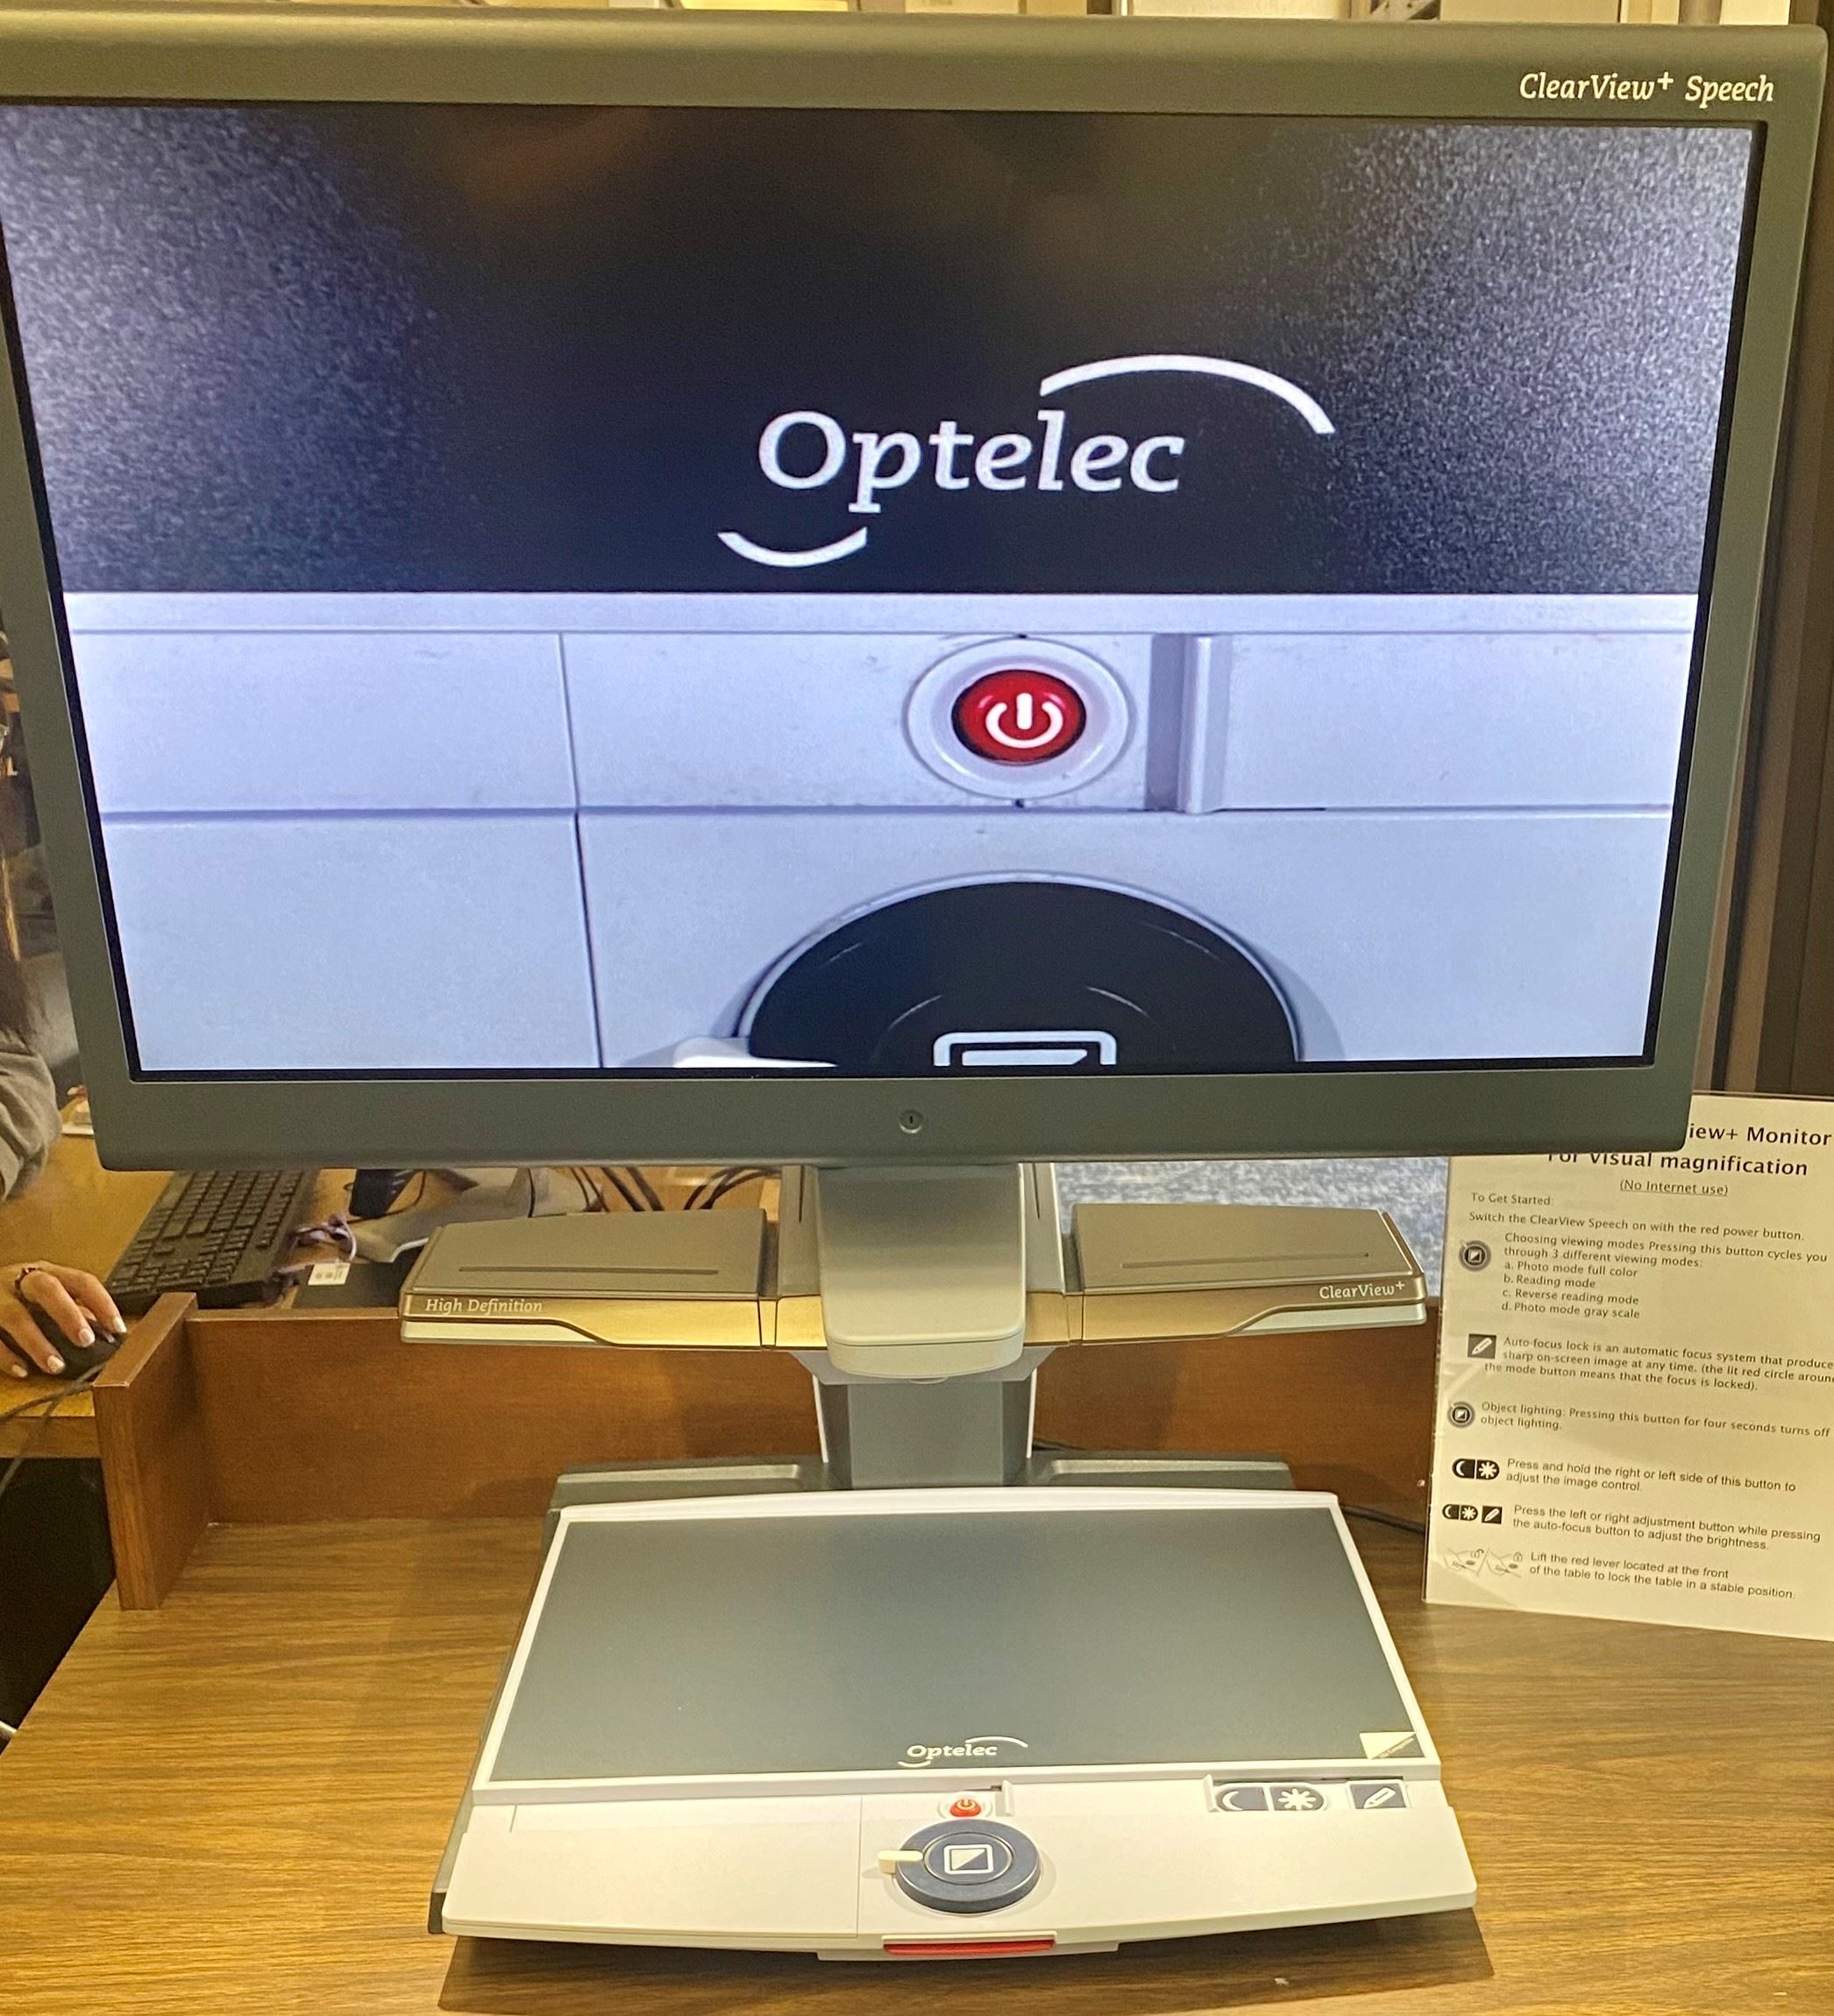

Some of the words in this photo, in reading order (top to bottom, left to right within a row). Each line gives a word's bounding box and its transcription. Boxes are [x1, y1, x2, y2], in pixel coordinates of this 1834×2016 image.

[1519, 71, 1674, 100] ClearView+
[1685, 75, 1774, 109] Speech
[758, 409, 1185, 513] Optelec
[1747, 1126, 1832, 1146] Monitor
[1660, 1155, 1808, 1175] magnification
[1473, 1191, 1484, 1202] To
[1489, 1192, 1507, 1203] Get
[1620, 1180, 1642, 1192] (No
[1646, 1181, 1697, 1193] Internet
[1702, 1184, 1729, 1196] use)
[1469, 1210, 1504, 1222] Switch
[1509, 1213, 1526, 1224] the
[1530, 1214, 1584, 1227] ClearView
[1589, 1217, 1628, 1231] Speech
[1651, 1222, 1674, 1232] with
[1679, 1223, 1696, 1233] the
[1701, 1225, 1719, 1235] red
[1724, 1228, 1760, 1239] power
[1763, 1228, 1804, 1240] button.
[1504, 1246, 1547, 1260] through
[1553, 1248, 1559, 1259] 3
[1562, 1249, 1610, 1261] different
[1615, 1253, 1657, 1267] viewing
[1505, 1232, 1557, 1246] Choosing
[1561, 1235, 1605, 1250] viewing
[1608, 1239, 1645, 1250] modes
[1649, 1240, 1696, 1256] Pressing
[1701, 1244, 1721, 1255] this
[1726, 1246, 1763, 1258] button
[1767, 1249, 1802, 1261] cycles
[1807, 1253, 1827, 1264] you
[1518, 1260, 1549, 1271] Photo
[1553, 1263, 1583, 1274] mode
[1588, 1264, 1605, 1275] full
[1610, 1266, 1637, 1277] color
[1319, 1281, 1405, 1299] ClearView+
[1504, 1273, 1514, 1282] b.
[1517, 1273, 1560, 1288] Reading
[1565, 1276, 1596, 1287] mode
[1516, 1287, 1558, 1300] Reverse
[1561, 1291, 1603, 1305] reading
[1608, 1294, 1639, 1304] mode
[425, 1298, 463, 1316] High
[468, 1298, 543, 1316] Definition
[1502, 1301, 1512, 1311] d.
[1515, 1302, 1546, 1313] Photo
[1550, 1304, 1580, 1315] mode
[1584, 1308, 1608, 1319] gray
[1612, 1308, 1639, 1318] scale
[1567, 1340, 1589, 1352] lock
[1593, 1342, 1601, 1352] is
[1606, 1345, 1618, 1354] an
[1623, 1346, 1679, 1358] automatic
[1683, 1349, 1711, 1360] focus
[1717, 1353, 1756, 1364] system
[1760, 1354, 1782, 1366] that
[1485, 1361, 1502, 1372] the
[1506, 1364, 1536, 1374] mode
[1540, 1365, 1575, 1377] button
[1581, 1371, 1615, 1381] means
[1620, 1371, 1641, 1382] that
[1646, 1373, 1663, 1383] the
[1667, 1374, 1696, 1386] focus
[1701, 1376, 1710, 1387] is
[1714, 1377, 1759, 1392] locked).
[1503, 1350, 1533, 1363] sharp
[1537, 1354, 1589, 1365] on-screen
[1594, 1355, 1627, 1370] image
[1631, 1360, 1643, 1369] at
[1646, 1362, 1667, 1374] any
[1669, 1361, 1699, 1373] time.
[1702, 1363, 1724, 1375] (the
[1725, 1365, 1739, 1376] lit
[1742, 1367, 1760, 1377] red
[1765, 1368, 1794, 1380] circle
[1798, 1373, 1834, 1383] aroun
[1481, 1415, 1513, 1428] object
[1482, 1401, 1517, 1415] Object
[1569, 1408, 1615, 1423] Pressing
[1619, 1411, 1639, 1422] this
[1644, 1413, 1680, 1425] button
[1684, 1416, 1701, 1427] for
[1704, 1417, 1726, 1429] four
[1731, 1421, 1775, 1432] seconds
[1781, 1423, 1809, 1434] turns
[1814, 1425, 1830, 1436] off
[1506, 1472, 1539, 1485] adjust
[1543, 1474, 1560, 1485] the
[1564, 1475, 1597, 1489] image
[1508, 1458, 1539, 1470] Press
[1543, 1461, 1563, 1472] and
[1567, 1462, 1590, 1474] hold
[1595, 1465, 1611, 1476] the
[1616, 1466, 1639, 1480] right
[1659, 1470, 1675, 1481] left
[1680, 1472, 1702, 1483] side
[1707, 1474, 1717, 1484] of
[1722, 1475, 1740, 1486] this
[1745, 1477, 1781, 1489] button
[1785, 1481, 1795, 1491] to
[1513, 1517, 1530, 1529] the
[1534, 1521, 1591, 1534] auto-focus
[1596, 1524, 1630, 1537] button
[1634, 1529, 1644, 1538] to
[1648, 1530, 1681, 1543] adjust
[1686, 1532, 1703, 1543] the
[1515, 1504, 1545, 1516] Press
[1549, 1508, 1566, 1518] the
[1570, 1508, 1586, 1520] left
[1605, 1512, 1629, 1525] right
[1633, 1515, 1695, 1530] adjustment
[1699, 1520, 1734, 1532] button
[1738, 1524, 1767, 1536] while
[1772, 1529, 1820, 1543] pressing
[1532, 1551, 1546, 1563] Lift
[1551, 1553, 1567, 1564] the
[1572, 1556, 1589, 1565] red
[1593, 1556, 1621, 1568] lever
[1624, 1558, 1664, 1572] located
[1667, 1564, 1678, 1572] at
[1682, 1564, 1699, 1574] the
[1703, 1565, 1728, 1577] front
[1530, 1564, 1539, 1574] of
[1544, 1565, 1560, 1576] the
[1565, 1568, 1590, 1579] table
[1595, 1571, 1604, 1580] to
[1609, 1571, 1630, 1583] lock
[1634, 1574, 1651, 1585] the
[1655, 1577, 1682, 1587] table
[1687, 1579, 1695, 1589] in
[1710, 1582, 1744, 1594] stable
[907, 1743, 998, 1759] Optelec
